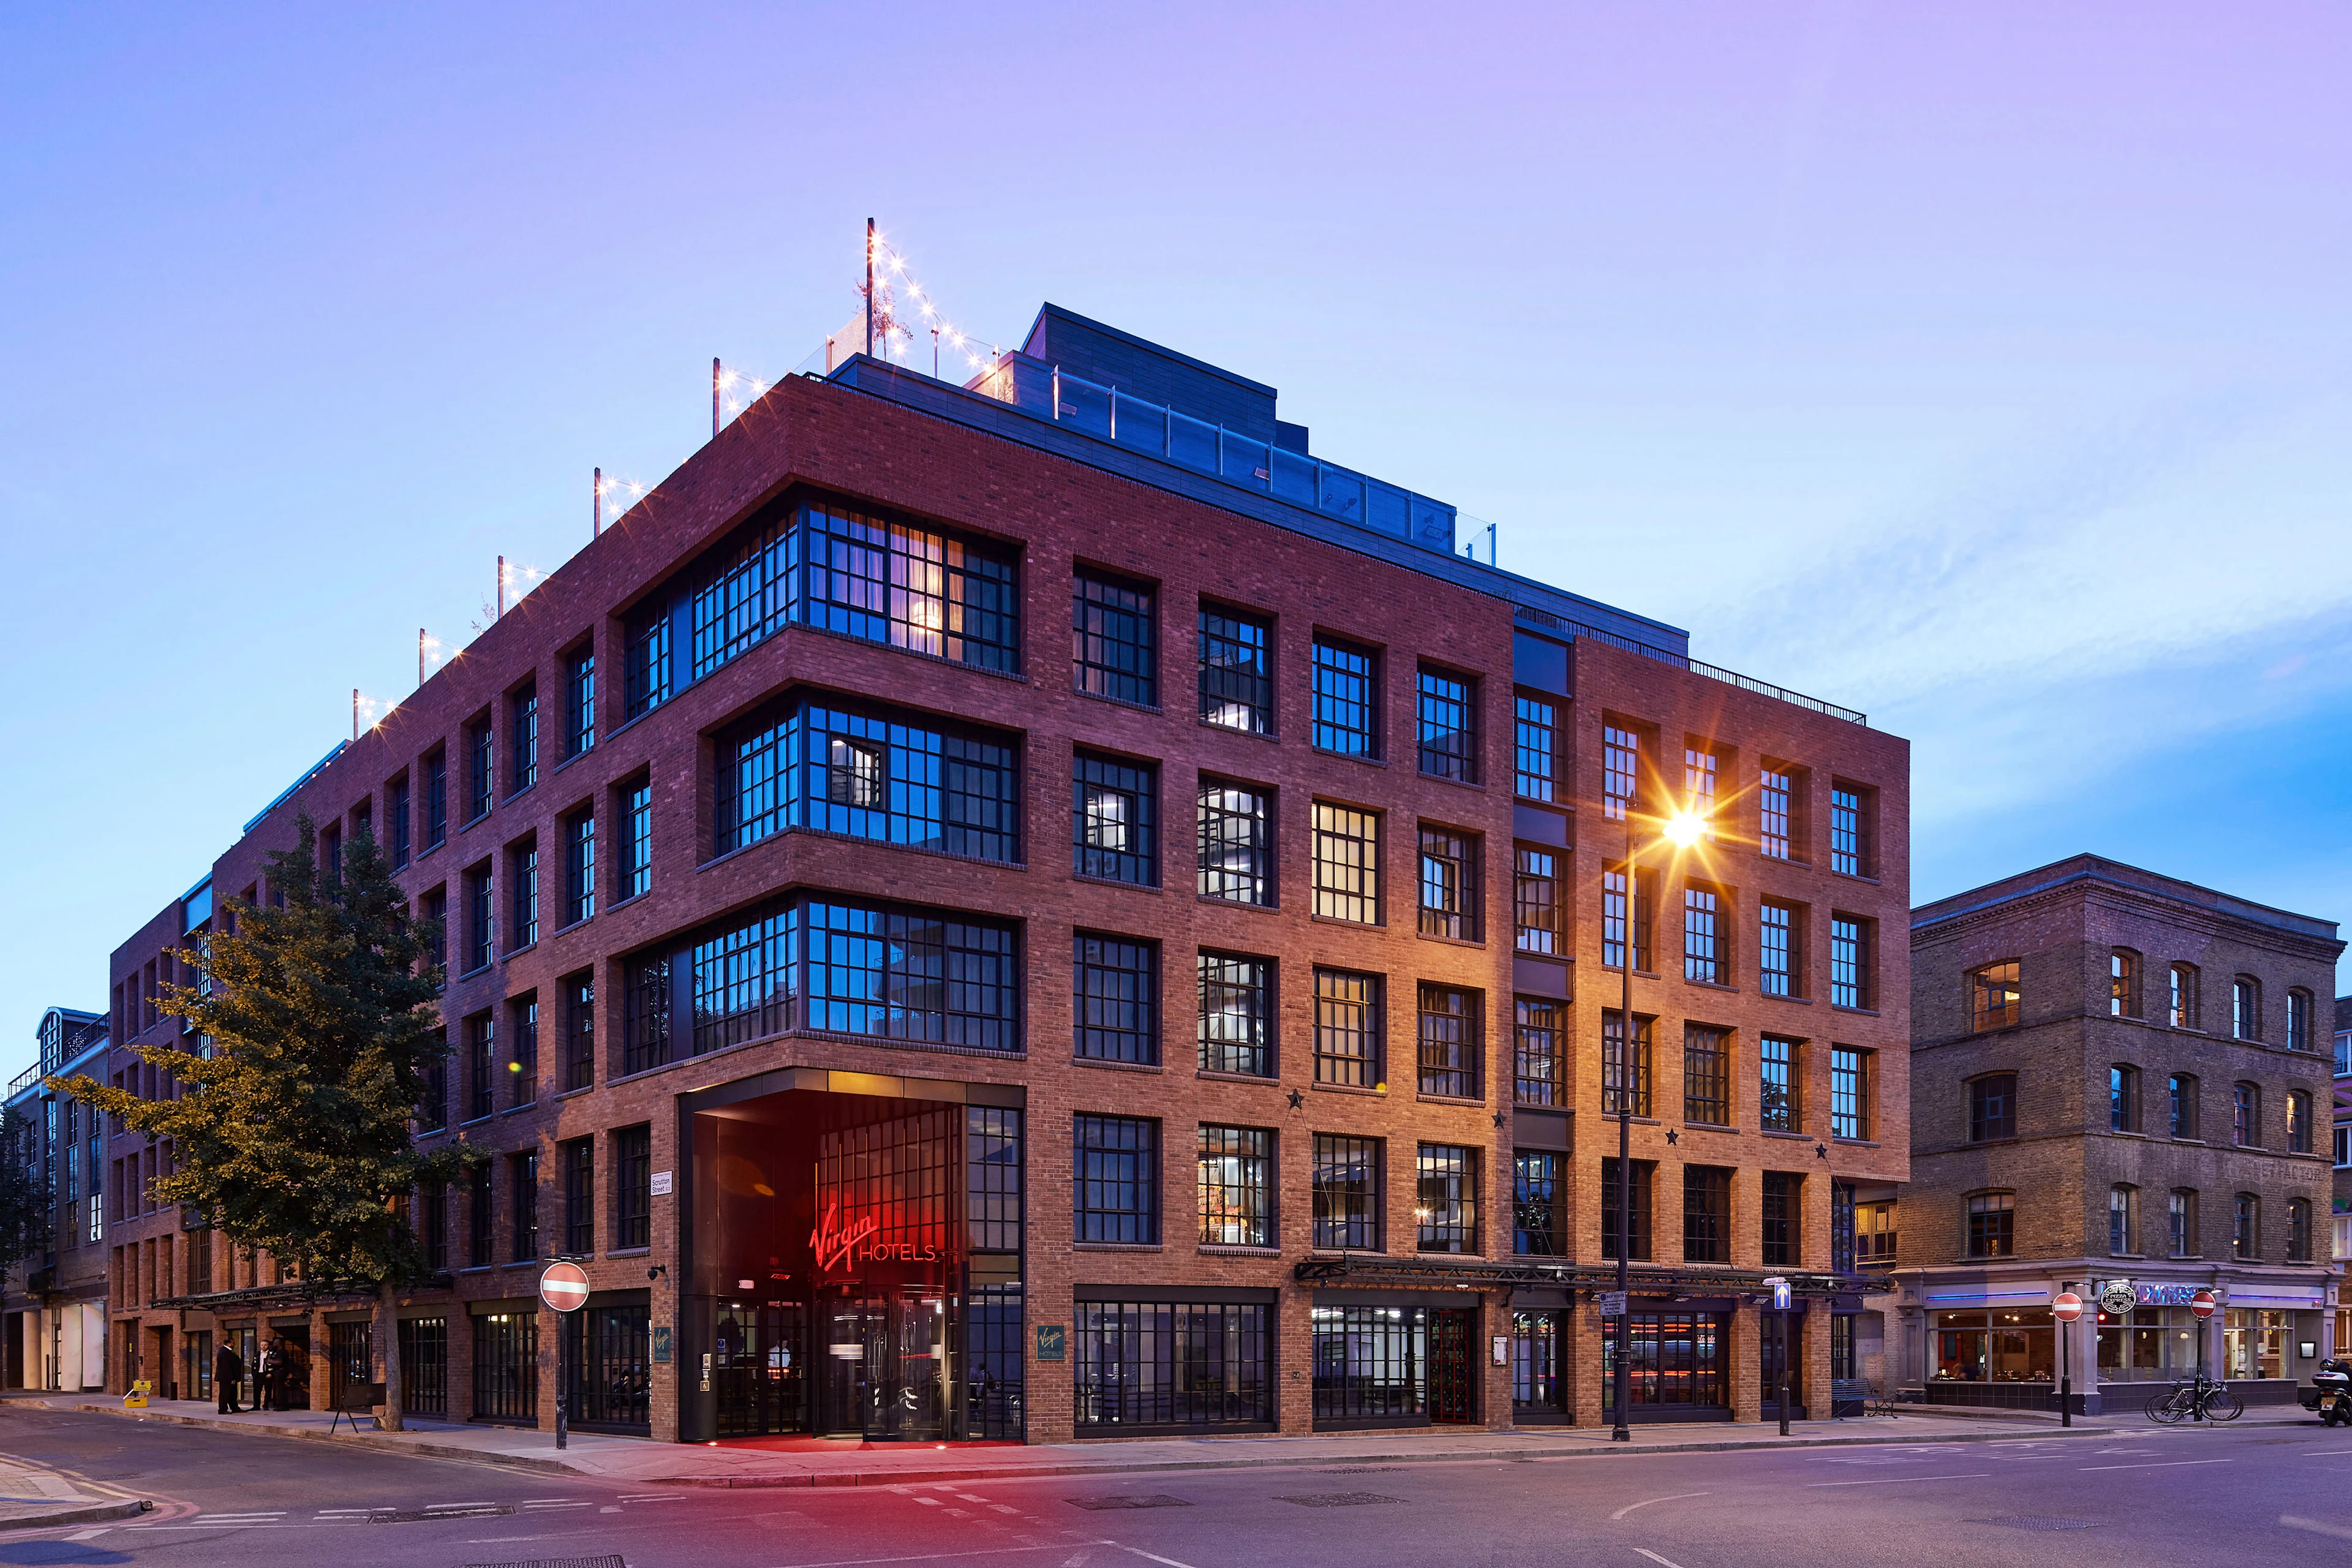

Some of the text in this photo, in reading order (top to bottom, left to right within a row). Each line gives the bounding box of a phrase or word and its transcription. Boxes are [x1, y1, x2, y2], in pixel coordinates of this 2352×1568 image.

[809, 1203, 878, 1272] Virgin
[859, 1244, 935, 1261] HOTELS
[655, 1329, 669, 1349] Virgin
[1038, 1327, 1061, 1348] Virgin
